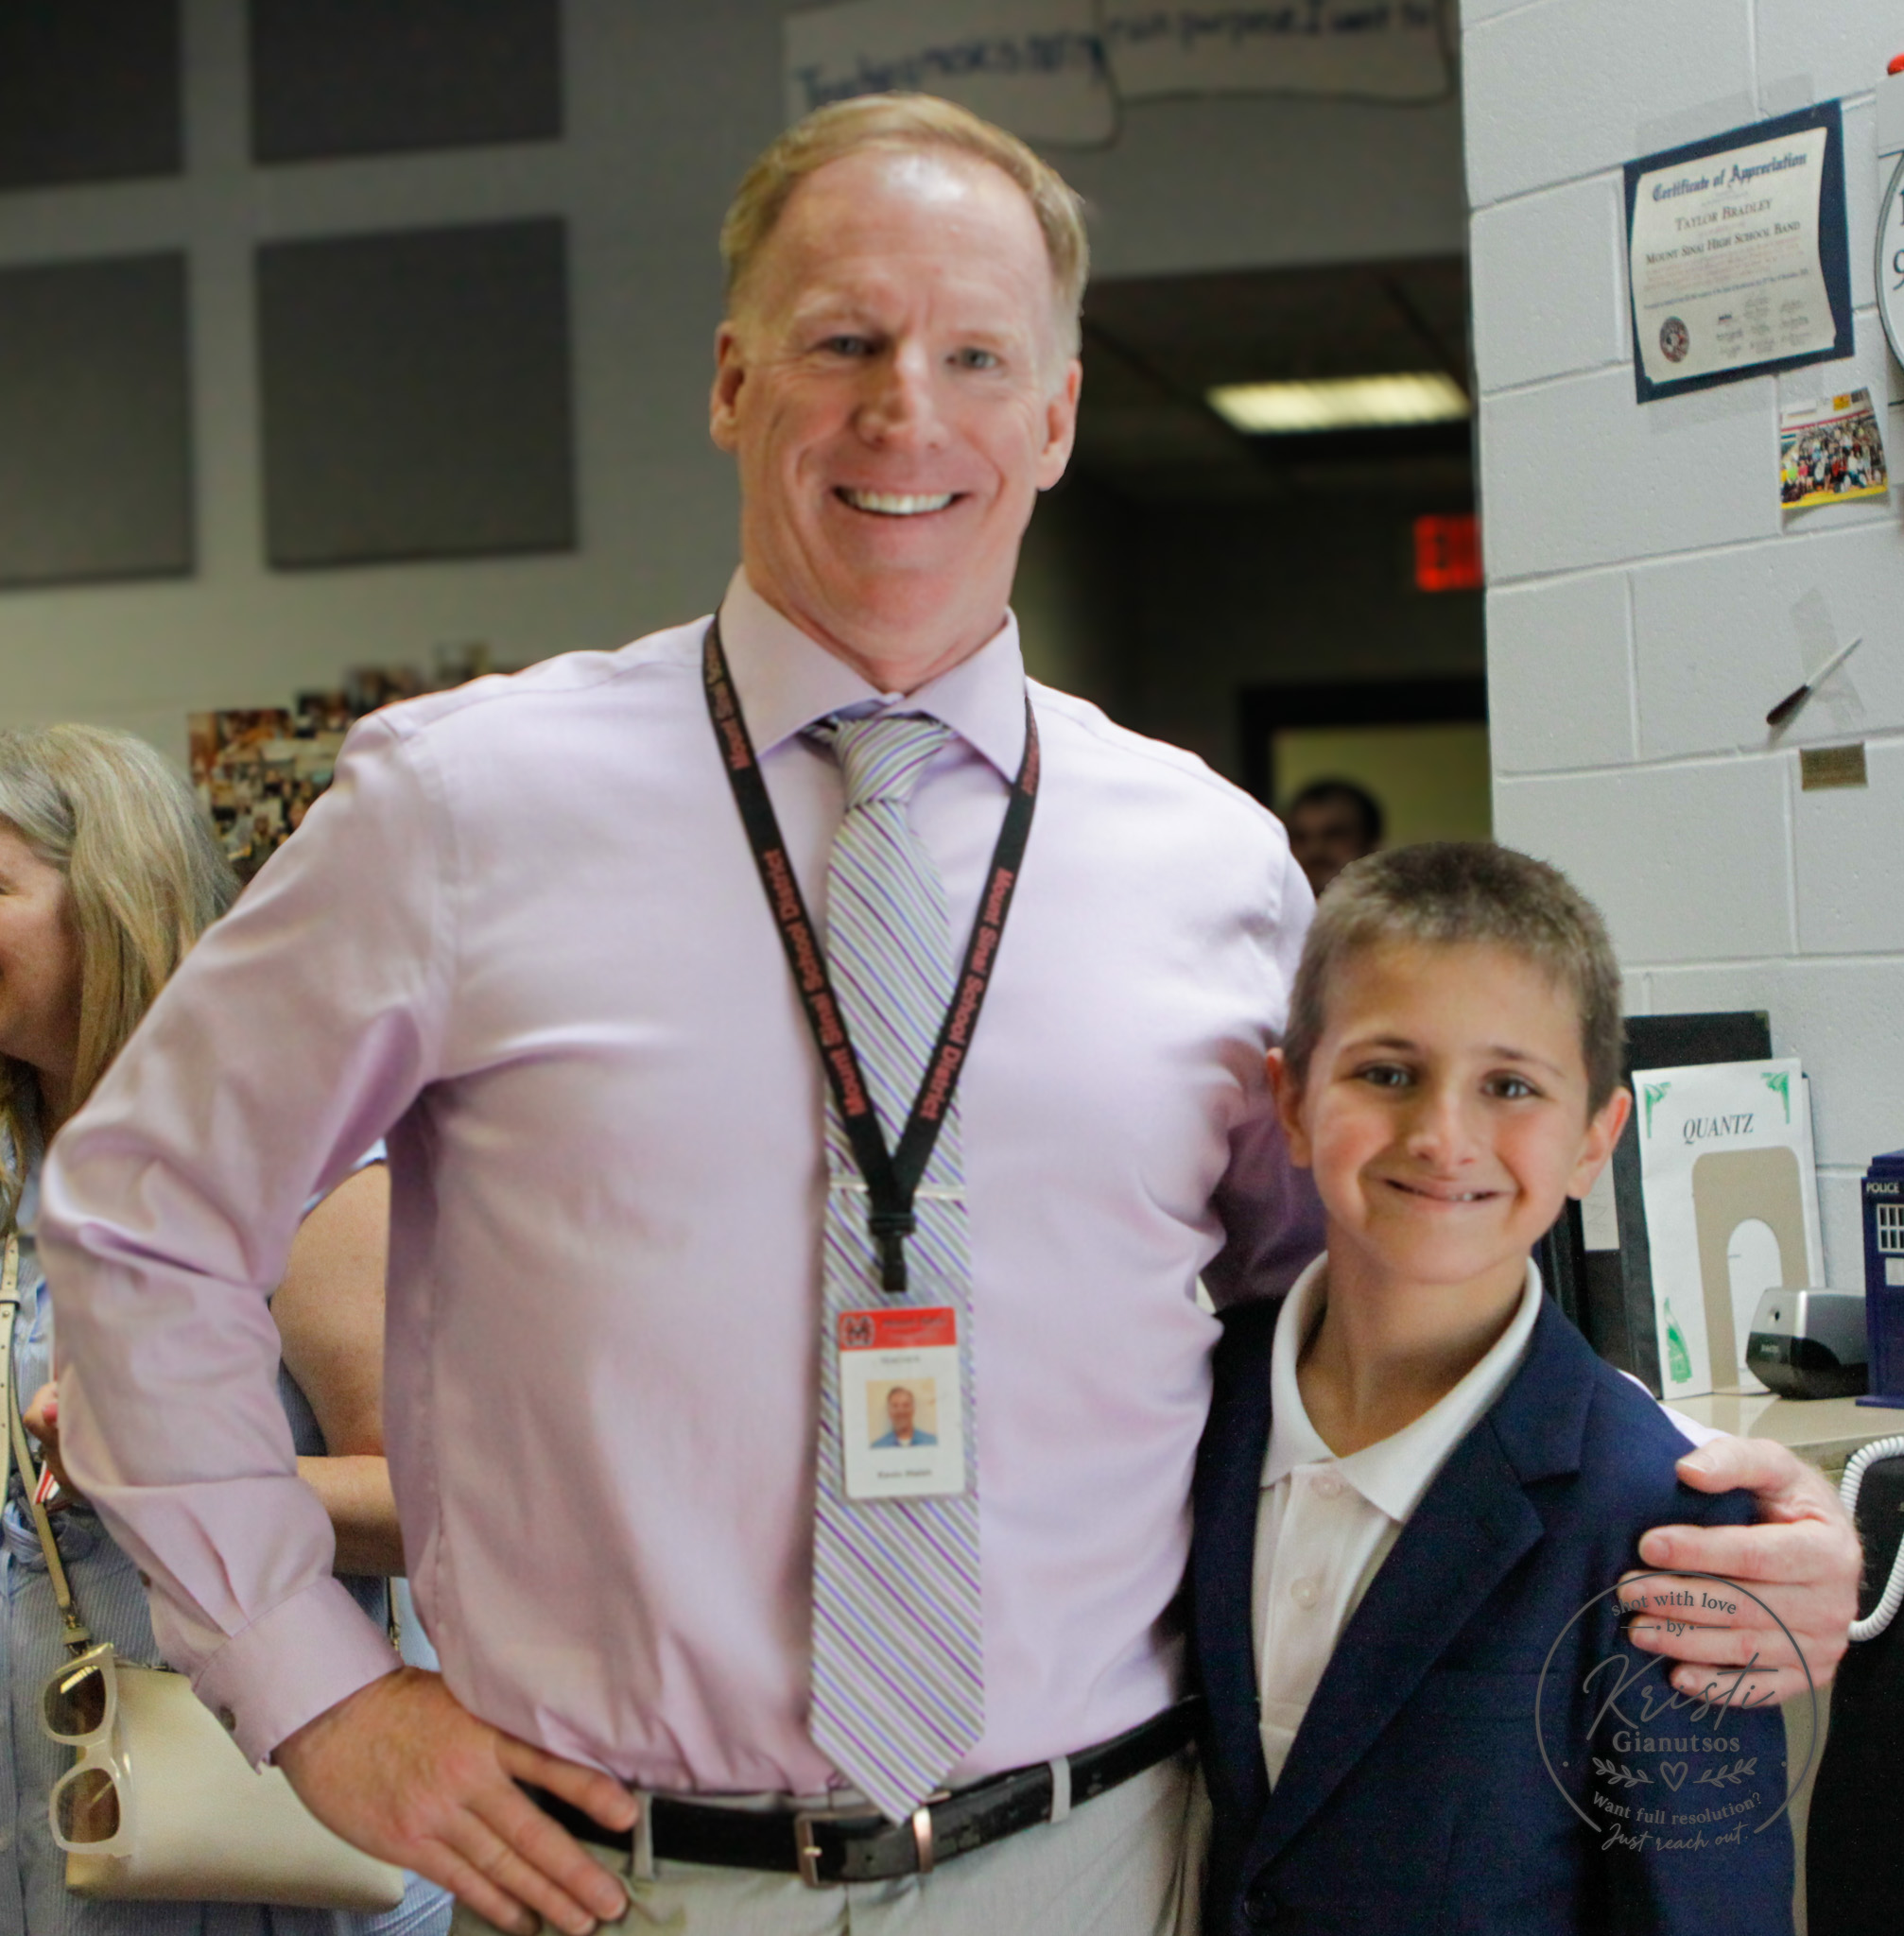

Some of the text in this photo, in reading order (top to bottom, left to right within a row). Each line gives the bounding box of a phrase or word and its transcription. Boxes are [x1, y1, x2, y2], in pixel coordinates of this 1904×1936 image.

[1653, 152, 1808, 201] Certificate of Appreciation
[1722, 199, 1773, 220] BRADLEY
[1646, 249, 1679, 265] MOUNT
[1707, 236, 1732, 251] HIGH
[1774, 221, 1801, 236] BAND
[1683, 1113, 1754, 1145] QUANTZ
[1866, 1182, 1899, 1193] POLICE
